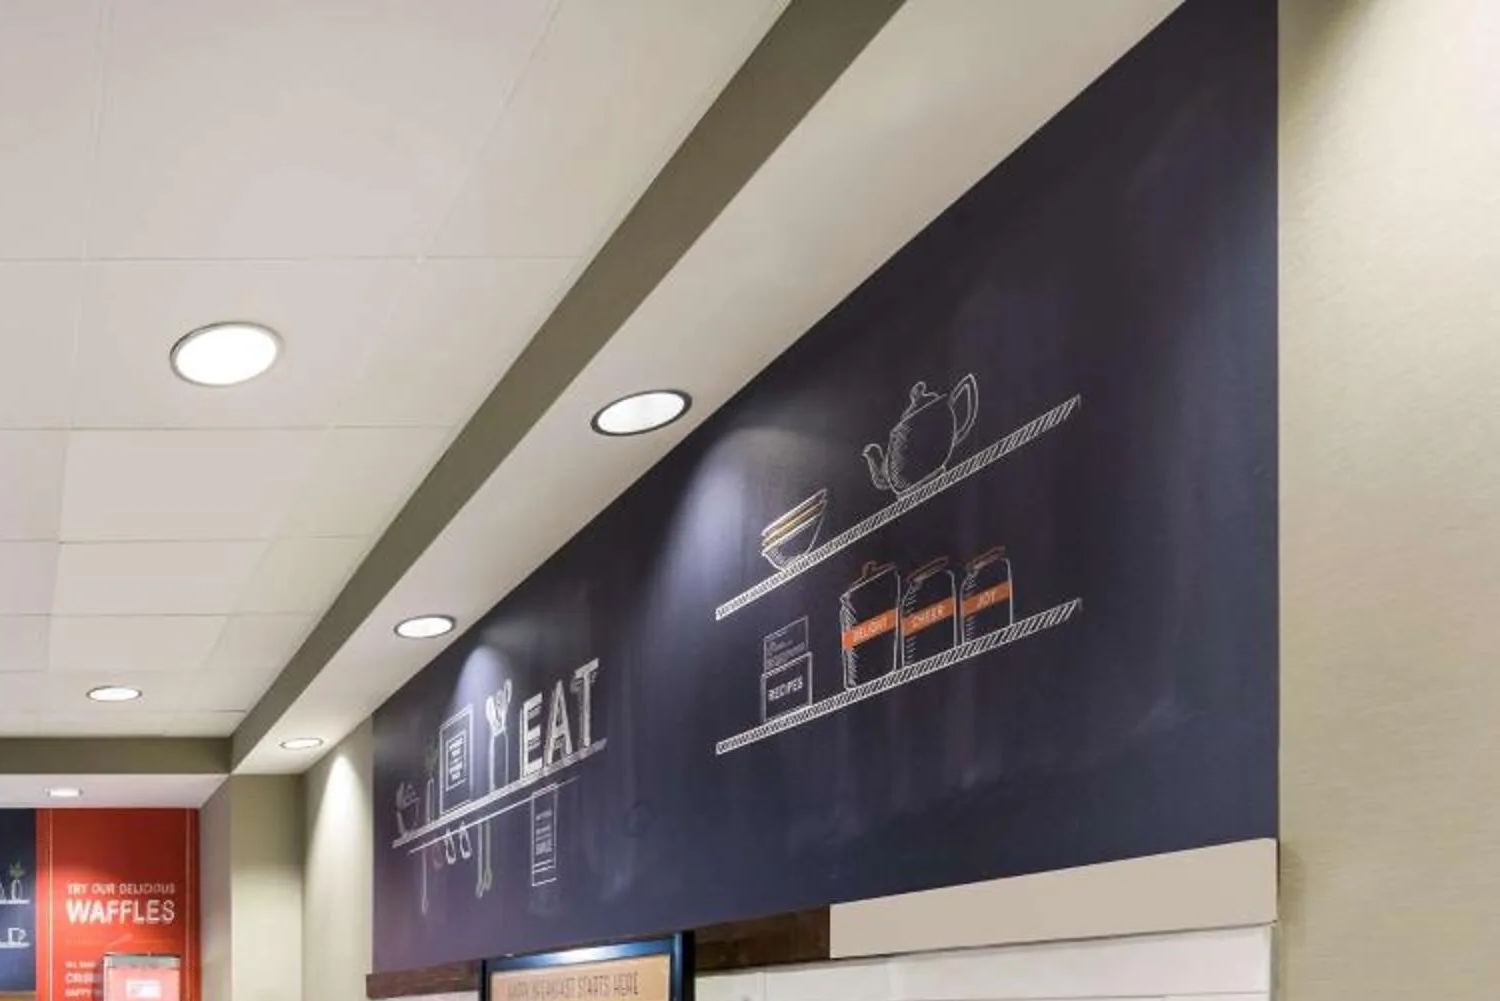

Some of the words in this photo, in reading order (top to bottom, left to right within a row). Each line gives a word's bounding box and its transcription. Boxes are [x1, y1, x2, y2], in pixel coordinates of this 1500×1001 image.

[767, 676, 804, 701] RECIPES
[519, 657, 599, 780] EAT
[67, 883, 87, 895] TRY
[91, 883, 115, 895] OUR
[119, 883, 176, 895] DELICIOUS
[65, 899, 176, 924] WAFFLES
[613, 971, 639, 996] HERE
